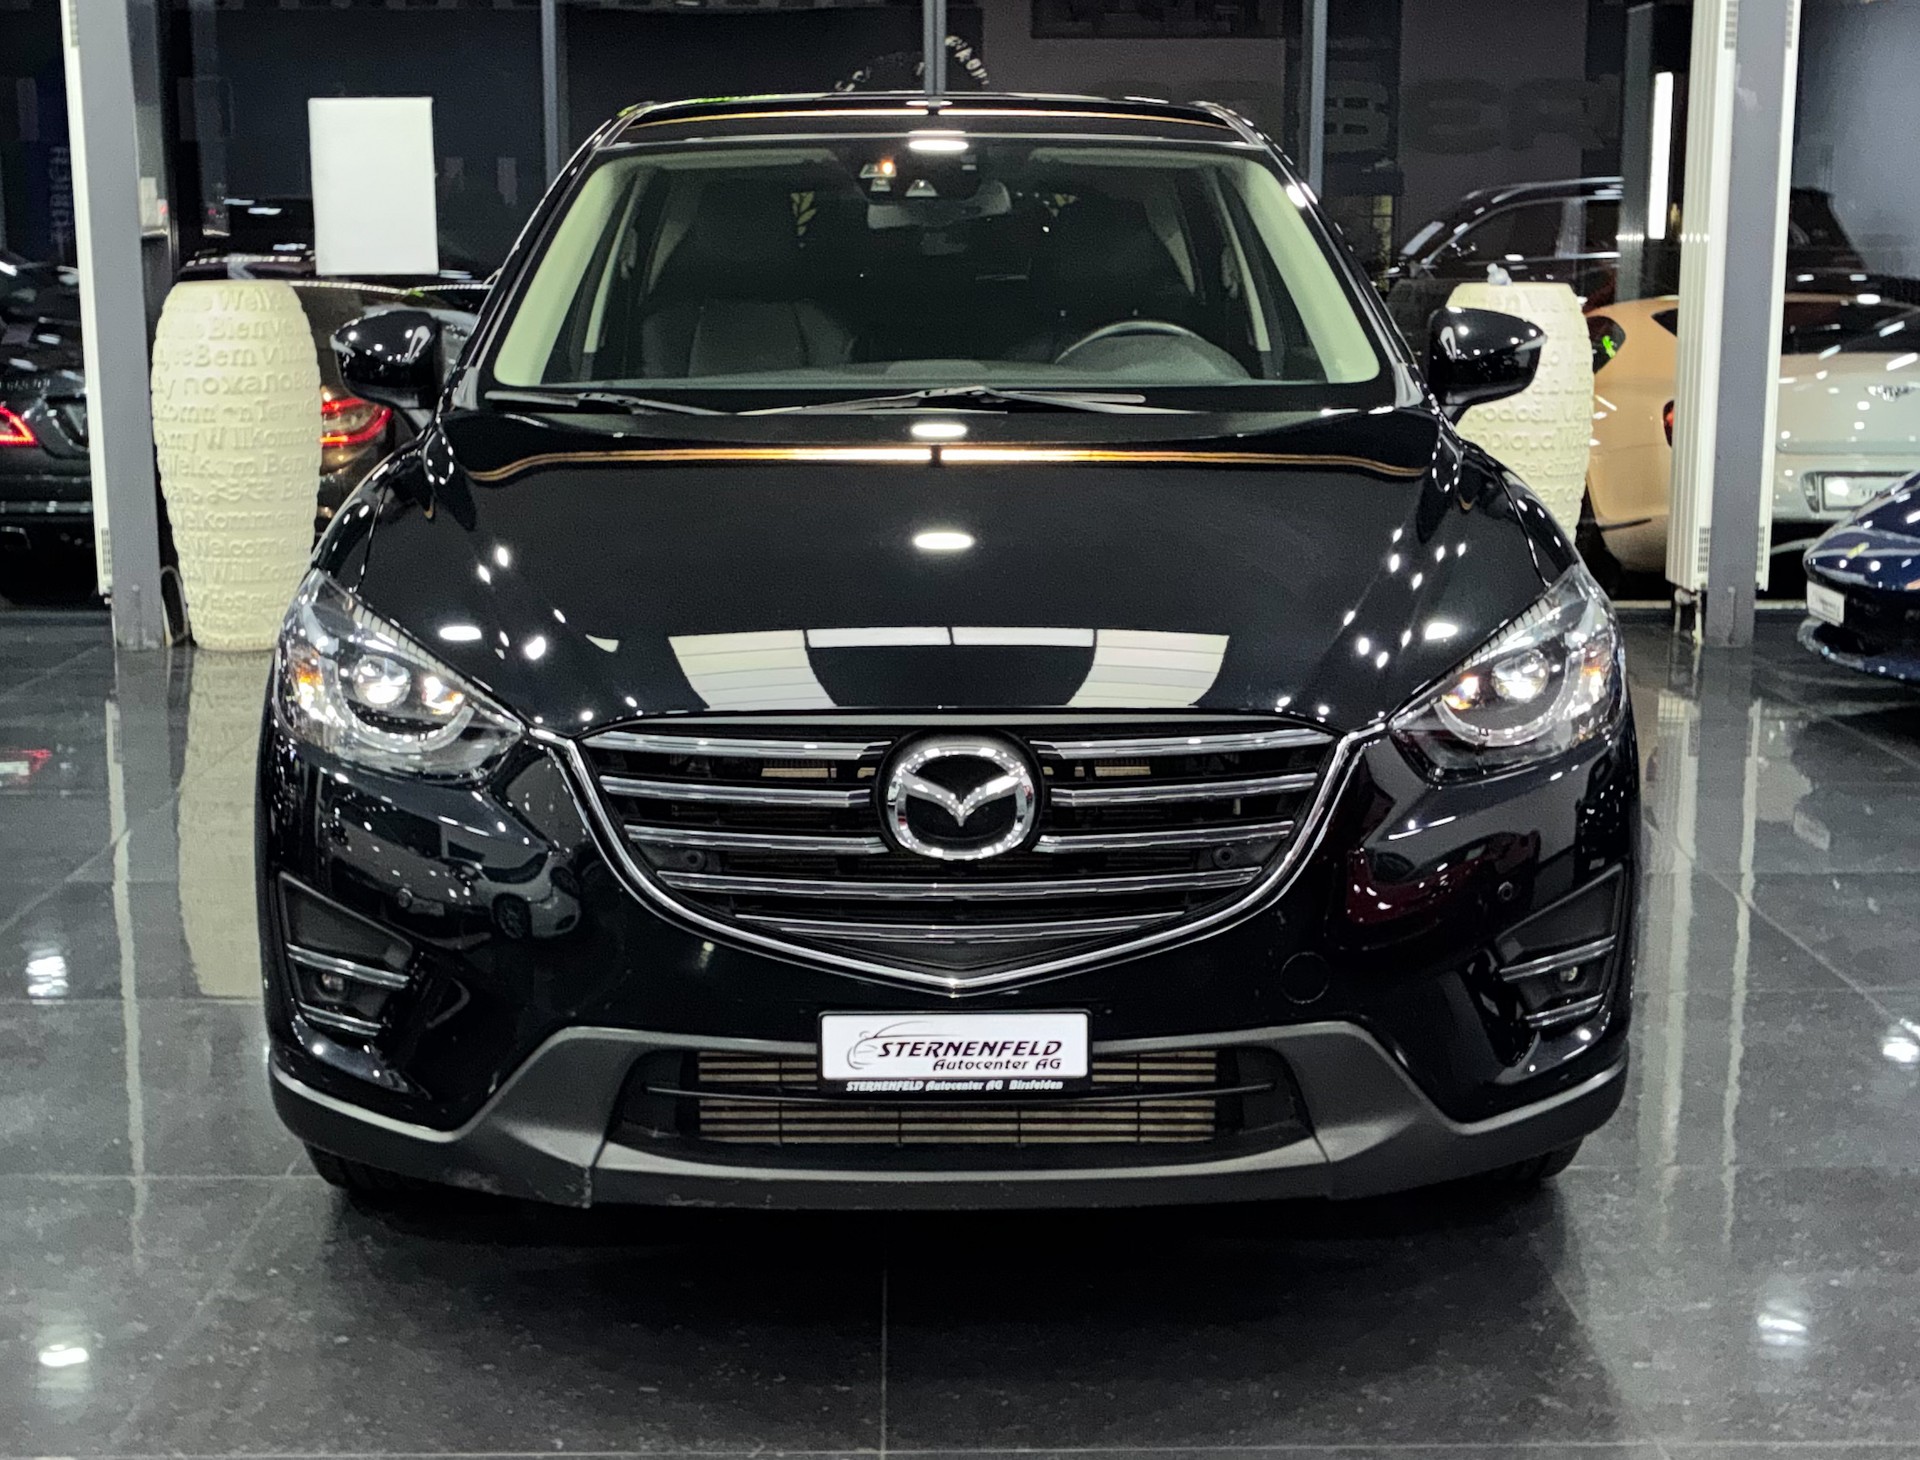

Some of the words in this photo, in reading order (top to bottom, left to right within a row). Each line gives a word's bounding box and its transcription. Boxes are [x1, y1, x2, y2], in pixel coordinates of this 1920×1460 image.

[878, 1041, 1062, 1057] STERNENFELD
[933, 1058, 1029, 1071] Autocenter
[1035, 1058, 1062, 1071] AG
[846, 1080, 923, 1092] STERNENFELD
[925, 1080, 984, 1092] Autocenter
[986, 1080, 1003, 1091] AG
